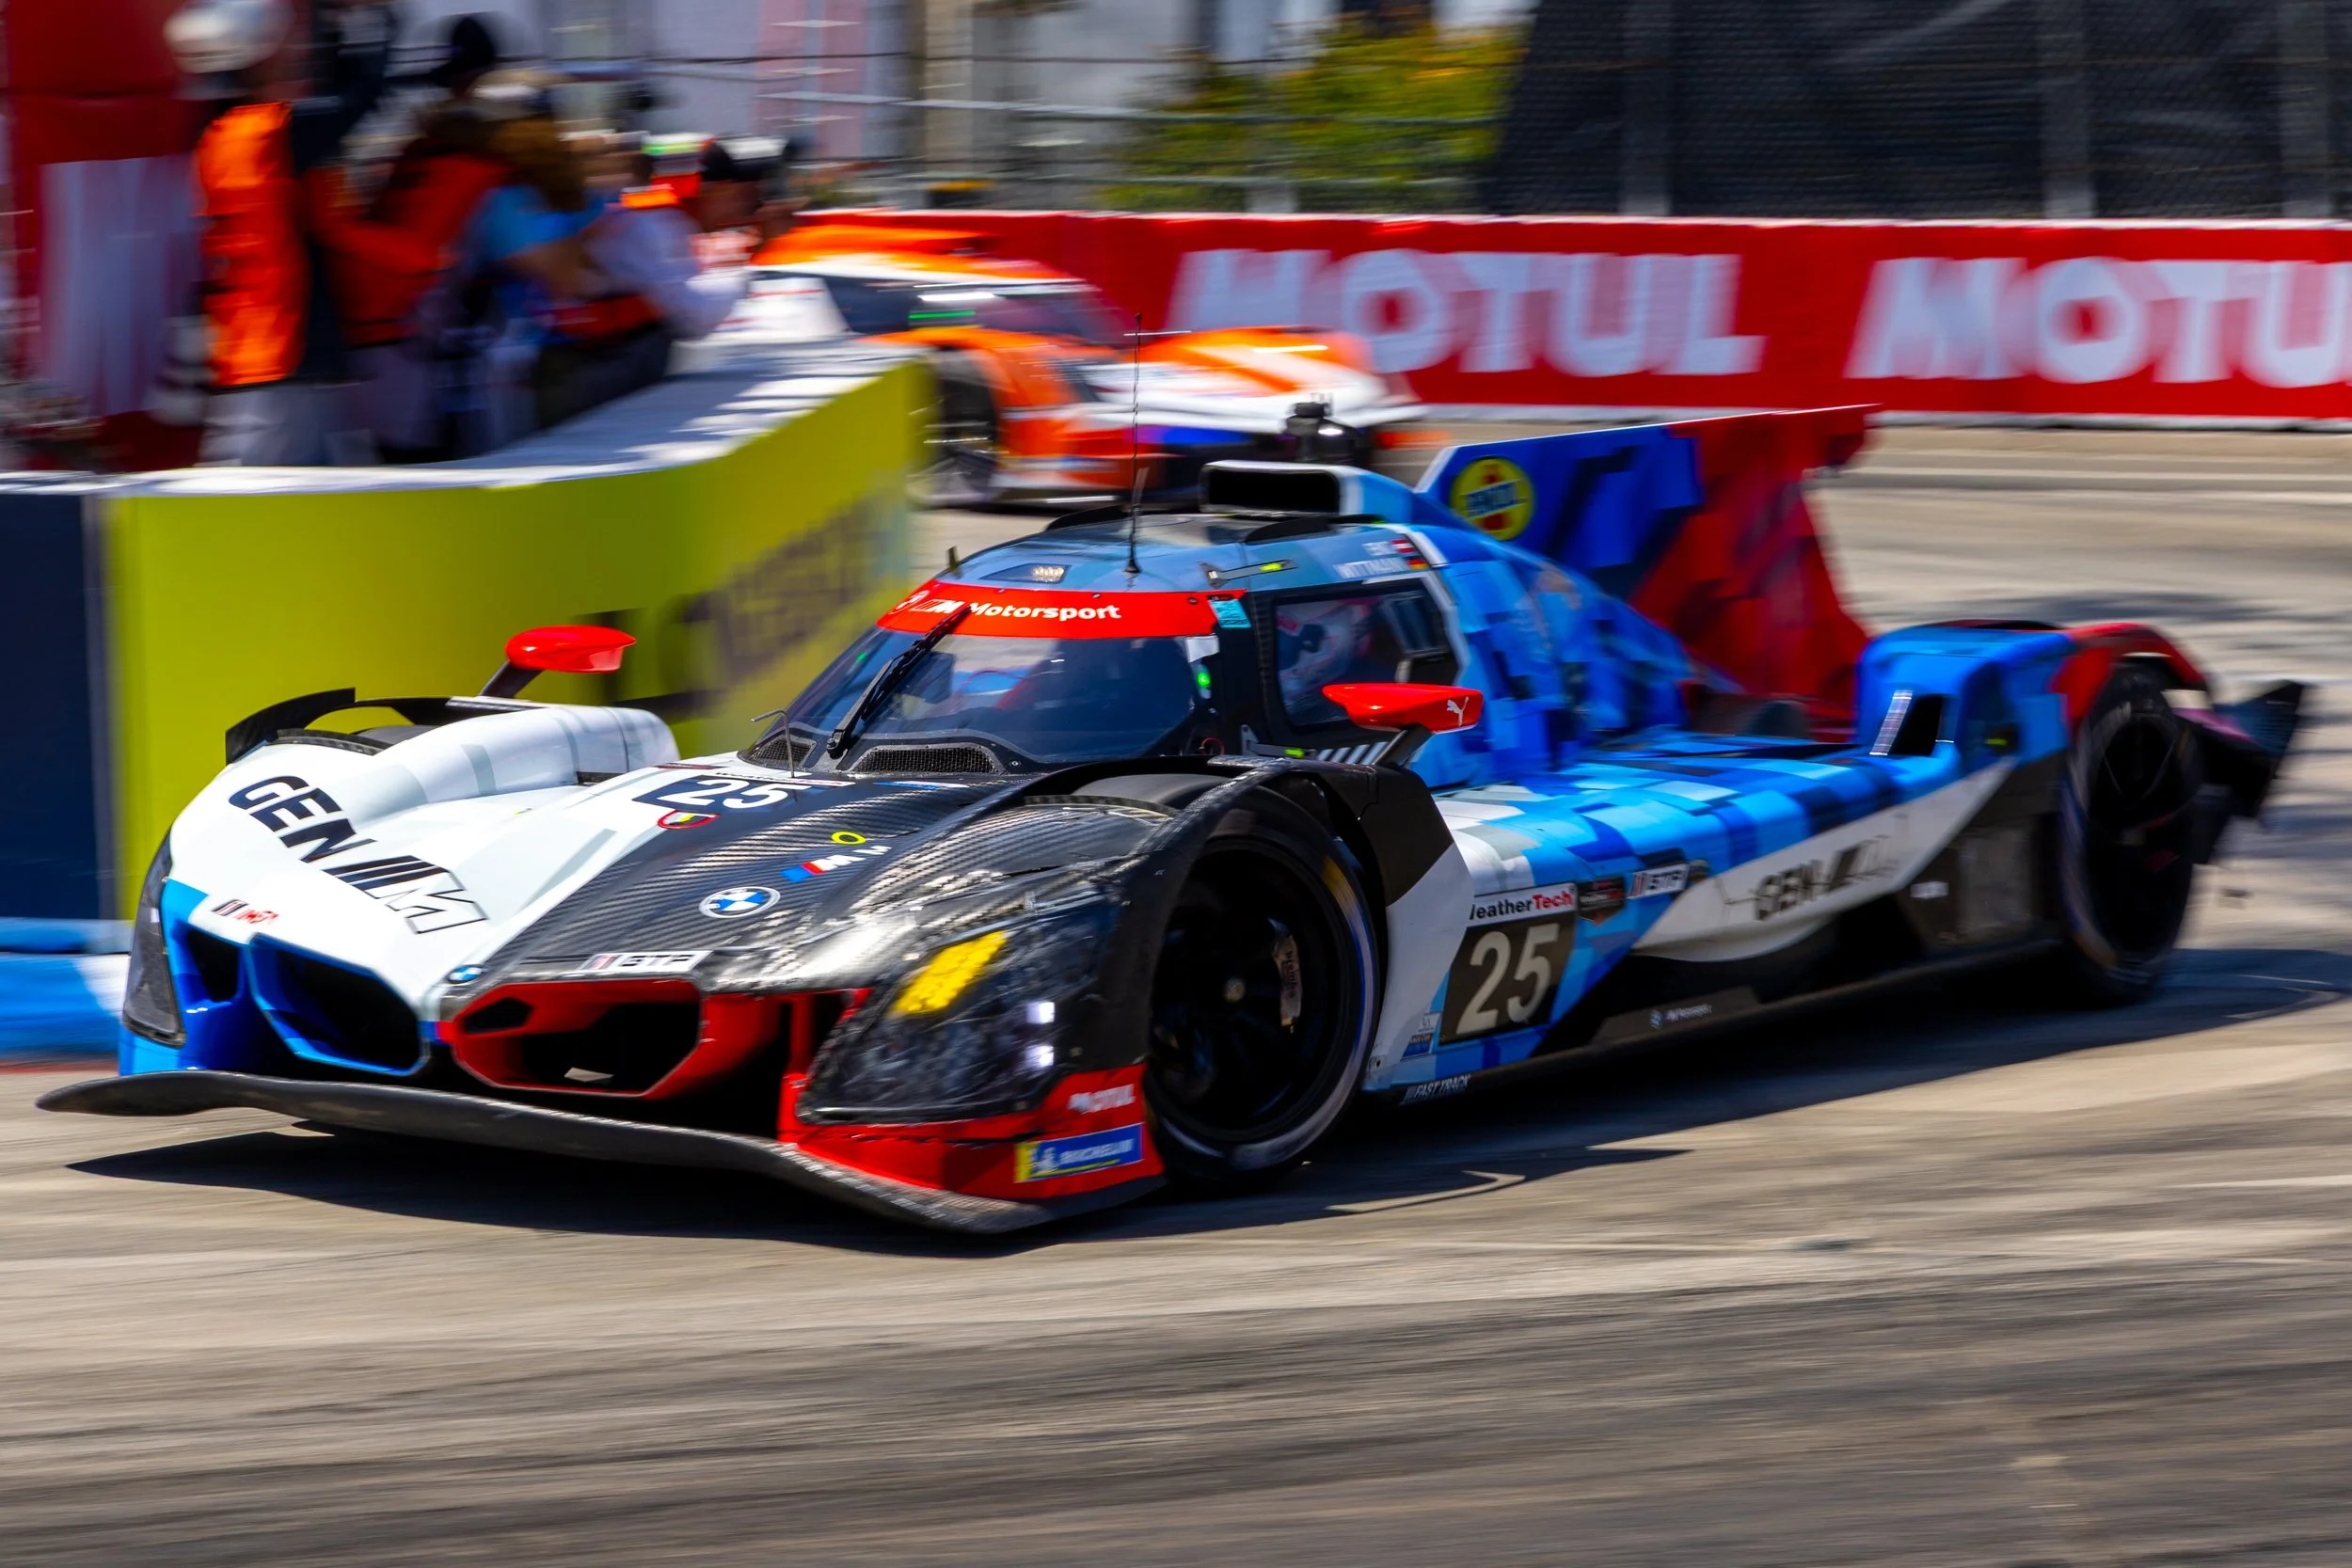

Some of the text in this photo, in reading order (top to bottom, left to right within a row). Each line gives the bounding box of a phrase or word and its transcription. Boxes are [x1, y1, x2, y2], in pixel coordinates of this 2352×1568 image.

[1167, 247, 1767, 376] MOTUL
[1842, 257, 2352, 389] MOTU
[968, 602, 1121, 621] Motorsport
[228, 775, 378, 863] GEN
[657, 779, 812, 809] 25
[1456, 924, 1560, 1035] 25
